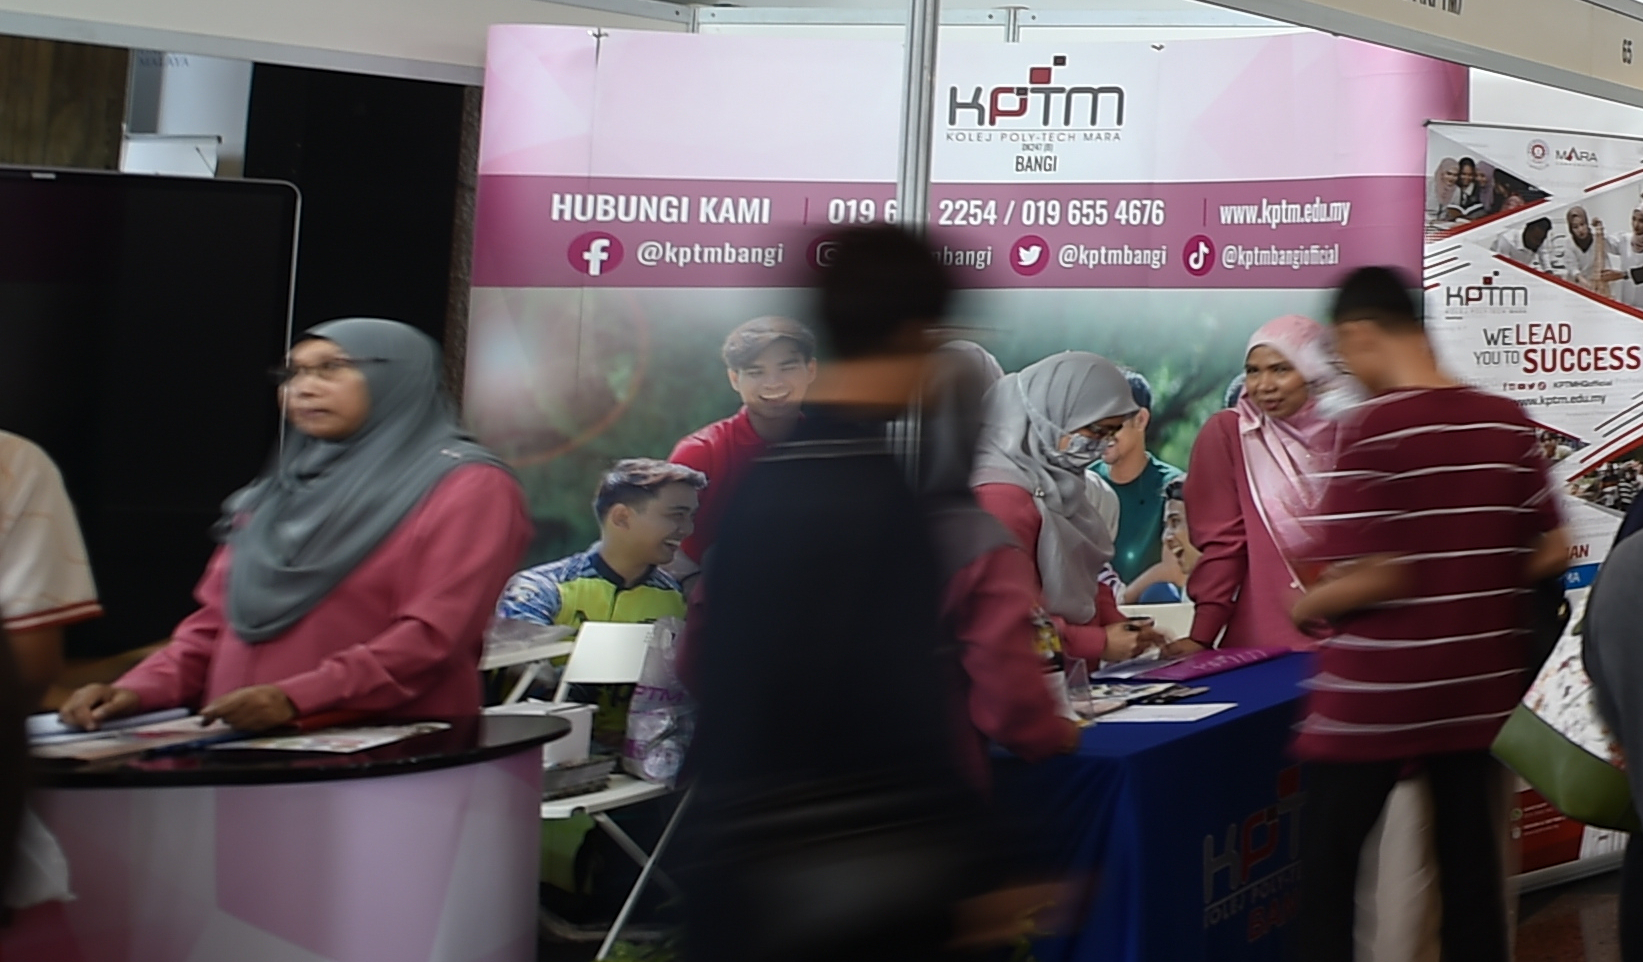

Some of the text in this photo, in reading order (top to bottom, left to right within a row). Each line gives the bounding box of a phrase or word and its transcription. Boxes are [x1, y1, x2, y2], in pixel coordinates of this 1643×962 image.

[946, 132, 1121, 142] KOLEJ POLY-TECH MARA
[1015, 155, 1058, 172] BANGI
[1555, 147, 1598, 162] MARA
[551, 193, 772, 225] HUBUNGI KAMI
[828, 199, 877, 226] 019
[938, 200, 998, 225] 2254
[1021, 200, 1061, 226] 019
[1067, 199, 1109, 225] 655
[1114, 199, 1165, 225] 4676
[1219, 198, 1352, 229] www.kptm.edu.my
[637, 240, 784, 269] @kptmbangi
[1058, 244, 1167, 270] @kptmbangi
[1222, 243, 1339, 270] @kptmbangiofficial
[1483, 323, 1572, 346] WE LEAD
[1474, 346, 1641, 374] YOU TO SUCCESS
